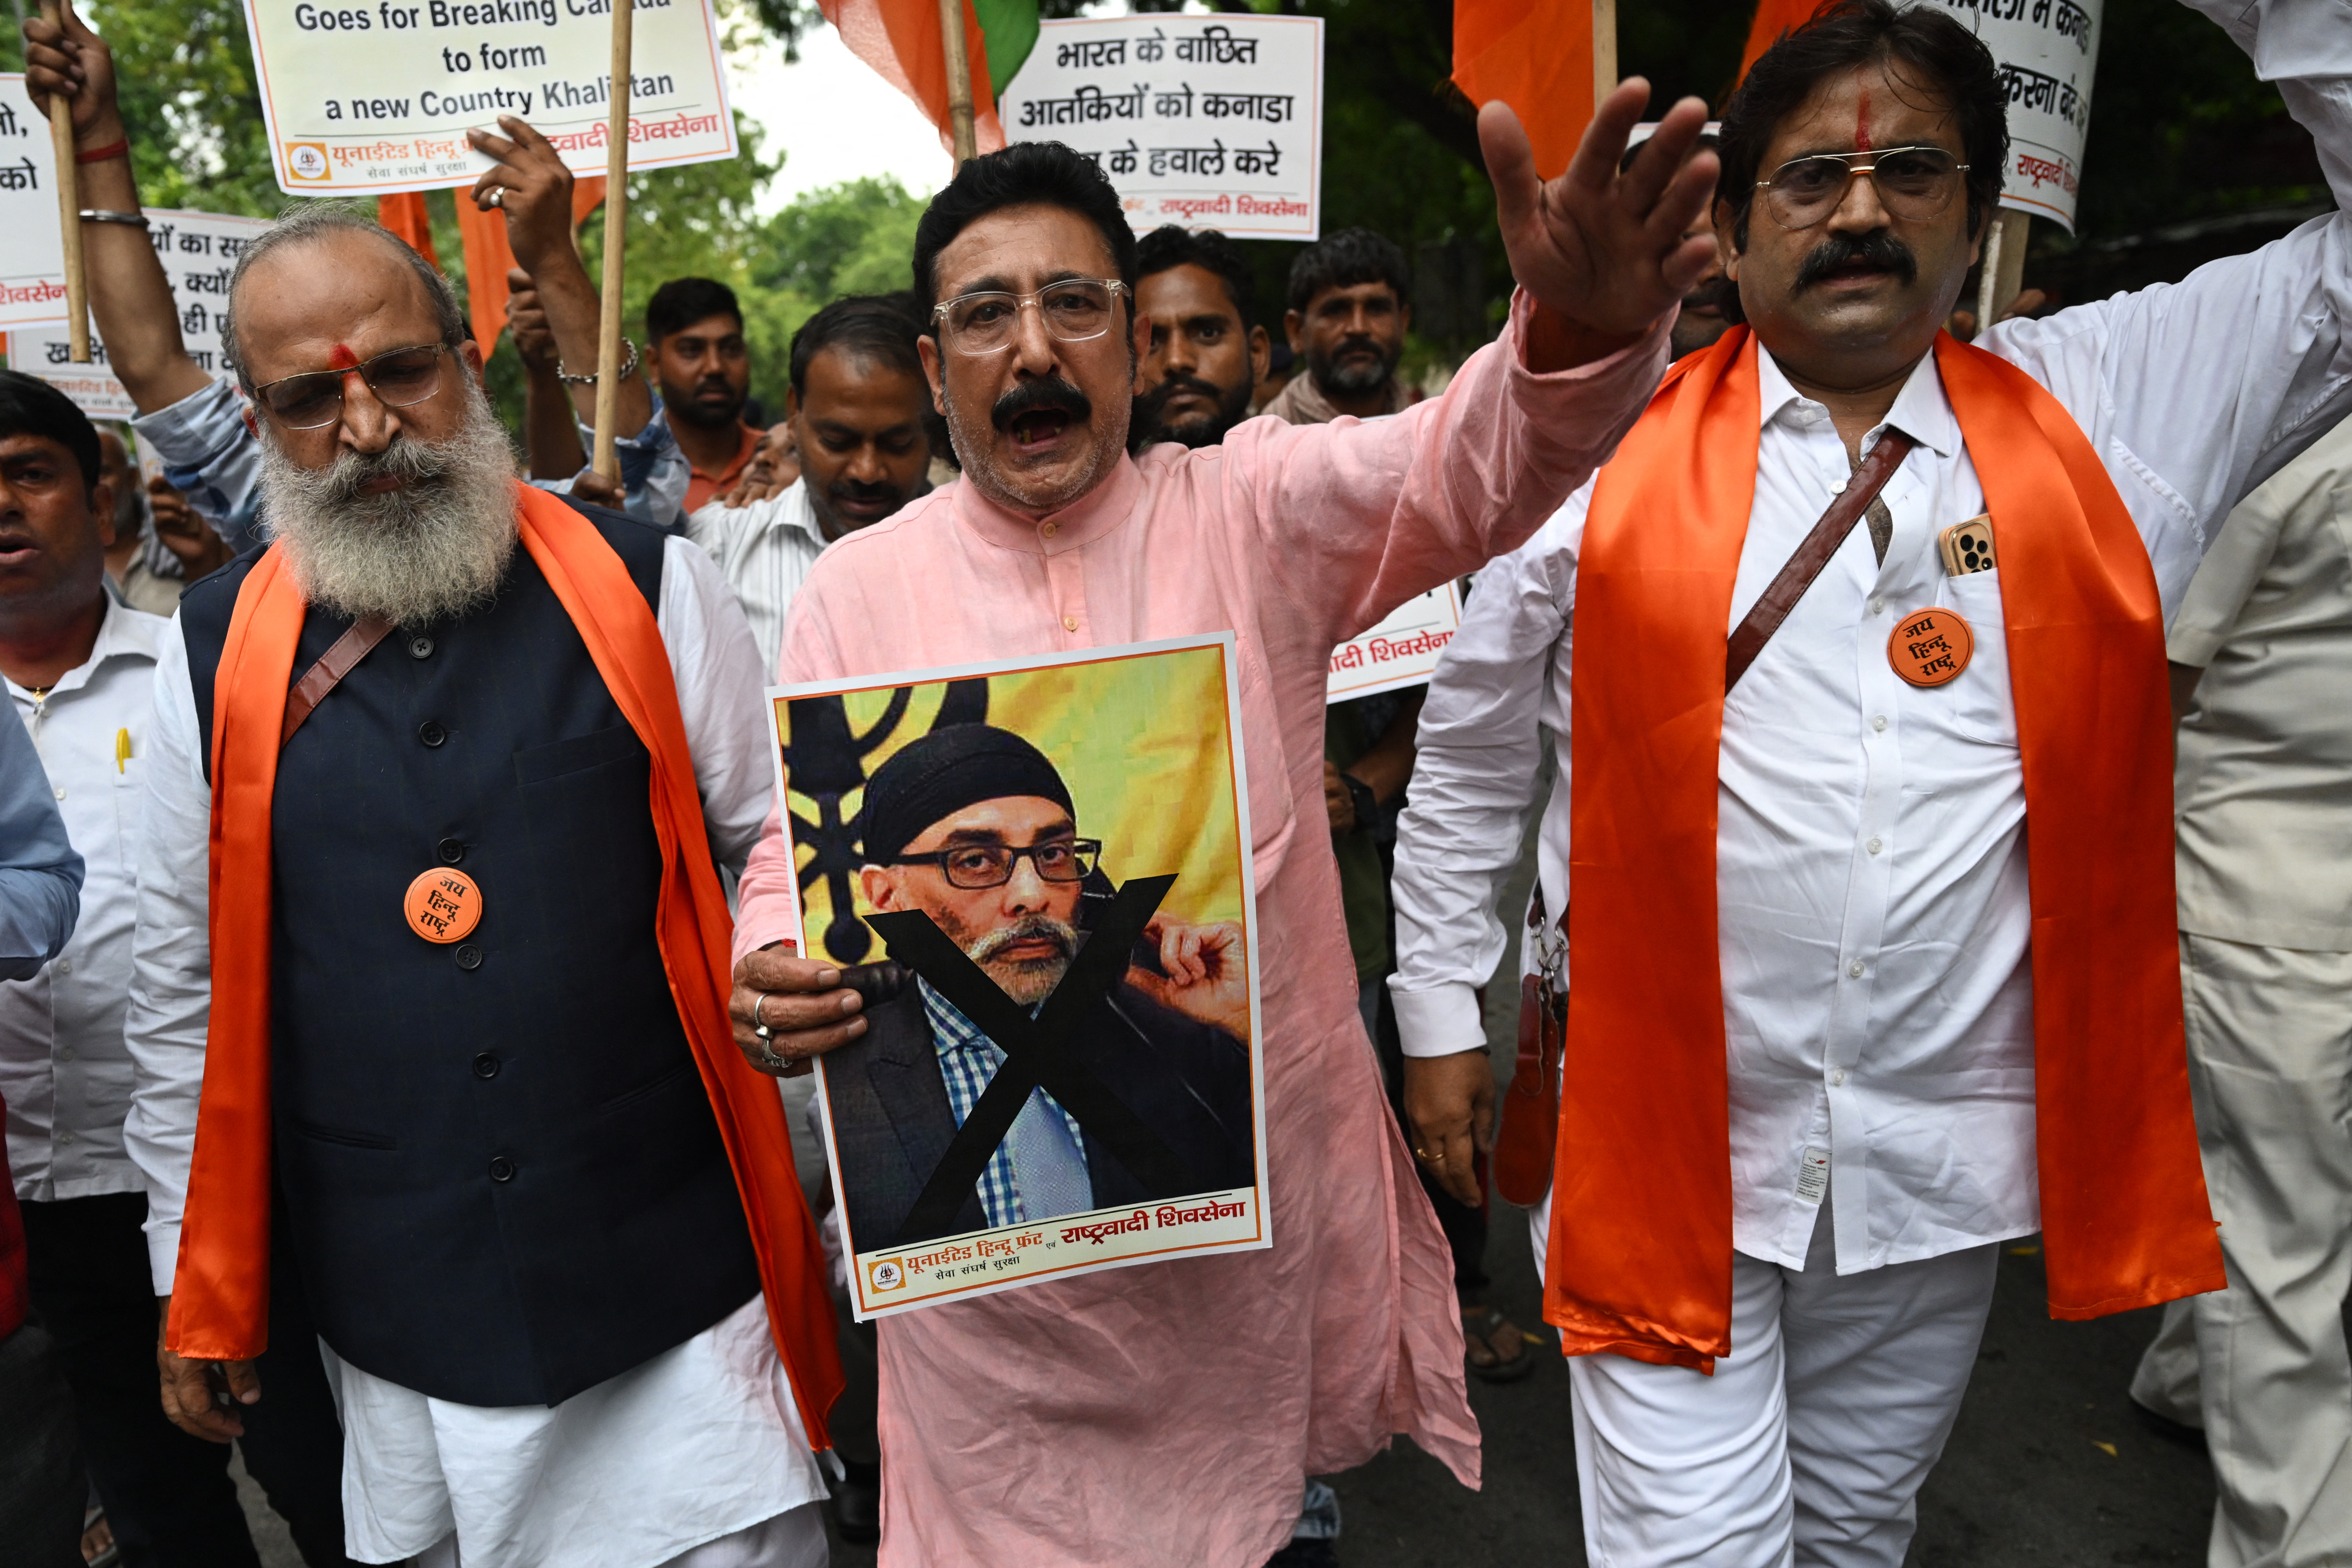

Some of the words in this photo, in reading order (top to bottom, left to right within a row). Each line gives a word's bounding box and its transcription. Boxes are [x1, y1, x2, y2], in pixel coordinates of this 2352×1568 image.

[295, 3, 371, 30] Goes
[379, 1, 419, 29] for
[429, 0, 557, 27] Breaking
[442, 46, 471, 72] to
[480, 43, 547, 70] form
[1057, 38, 1128, 68] भारत
[1135, 27, 1166, 64] के
[325, 100, 342, 119] a
[352, 98, 410, 119] new
[420, 87, 532, 116] Country
[543, 74, 674, 109] Khalitan
[1155, 82, 1194, 119] को
[1202, 91, 1295, 123] कनाडा
[414, 139, 460, 160] हिन्दू
[1110, 139, 1139, 175] के
[1148, 137, 1228, 177] हवाले
[1234, 139, 1282, 176] करे
[1237, 193, 1309, 217] शिवसेना
[179, 232, 210, 255] का
[1903, 617, 1935, 638] जय
[1369, 630, 1455, 663] शिवसेन
[1908, 634, 1952, 660] हिन्दू
[440, 876, 468, 898] जय
[427, 889, 461, 922] हिन्दू
[976, 1238, 1015, 1257] हिन्दू
[1015, 1231, 1043, 1250] फ्रंट
[1045, 1240, 1056, 1250] एवं
[1060, 1210, 1150, 1245] राष्ट्रवादी
[1155, 1200, 1246, 1228] शिवसेना
[934, 1269, 955, 1280] सेवा
[960, 1260, 987, 1275] संघर्ष
[992, 1255, 1021, 1270] सुरक्षा
